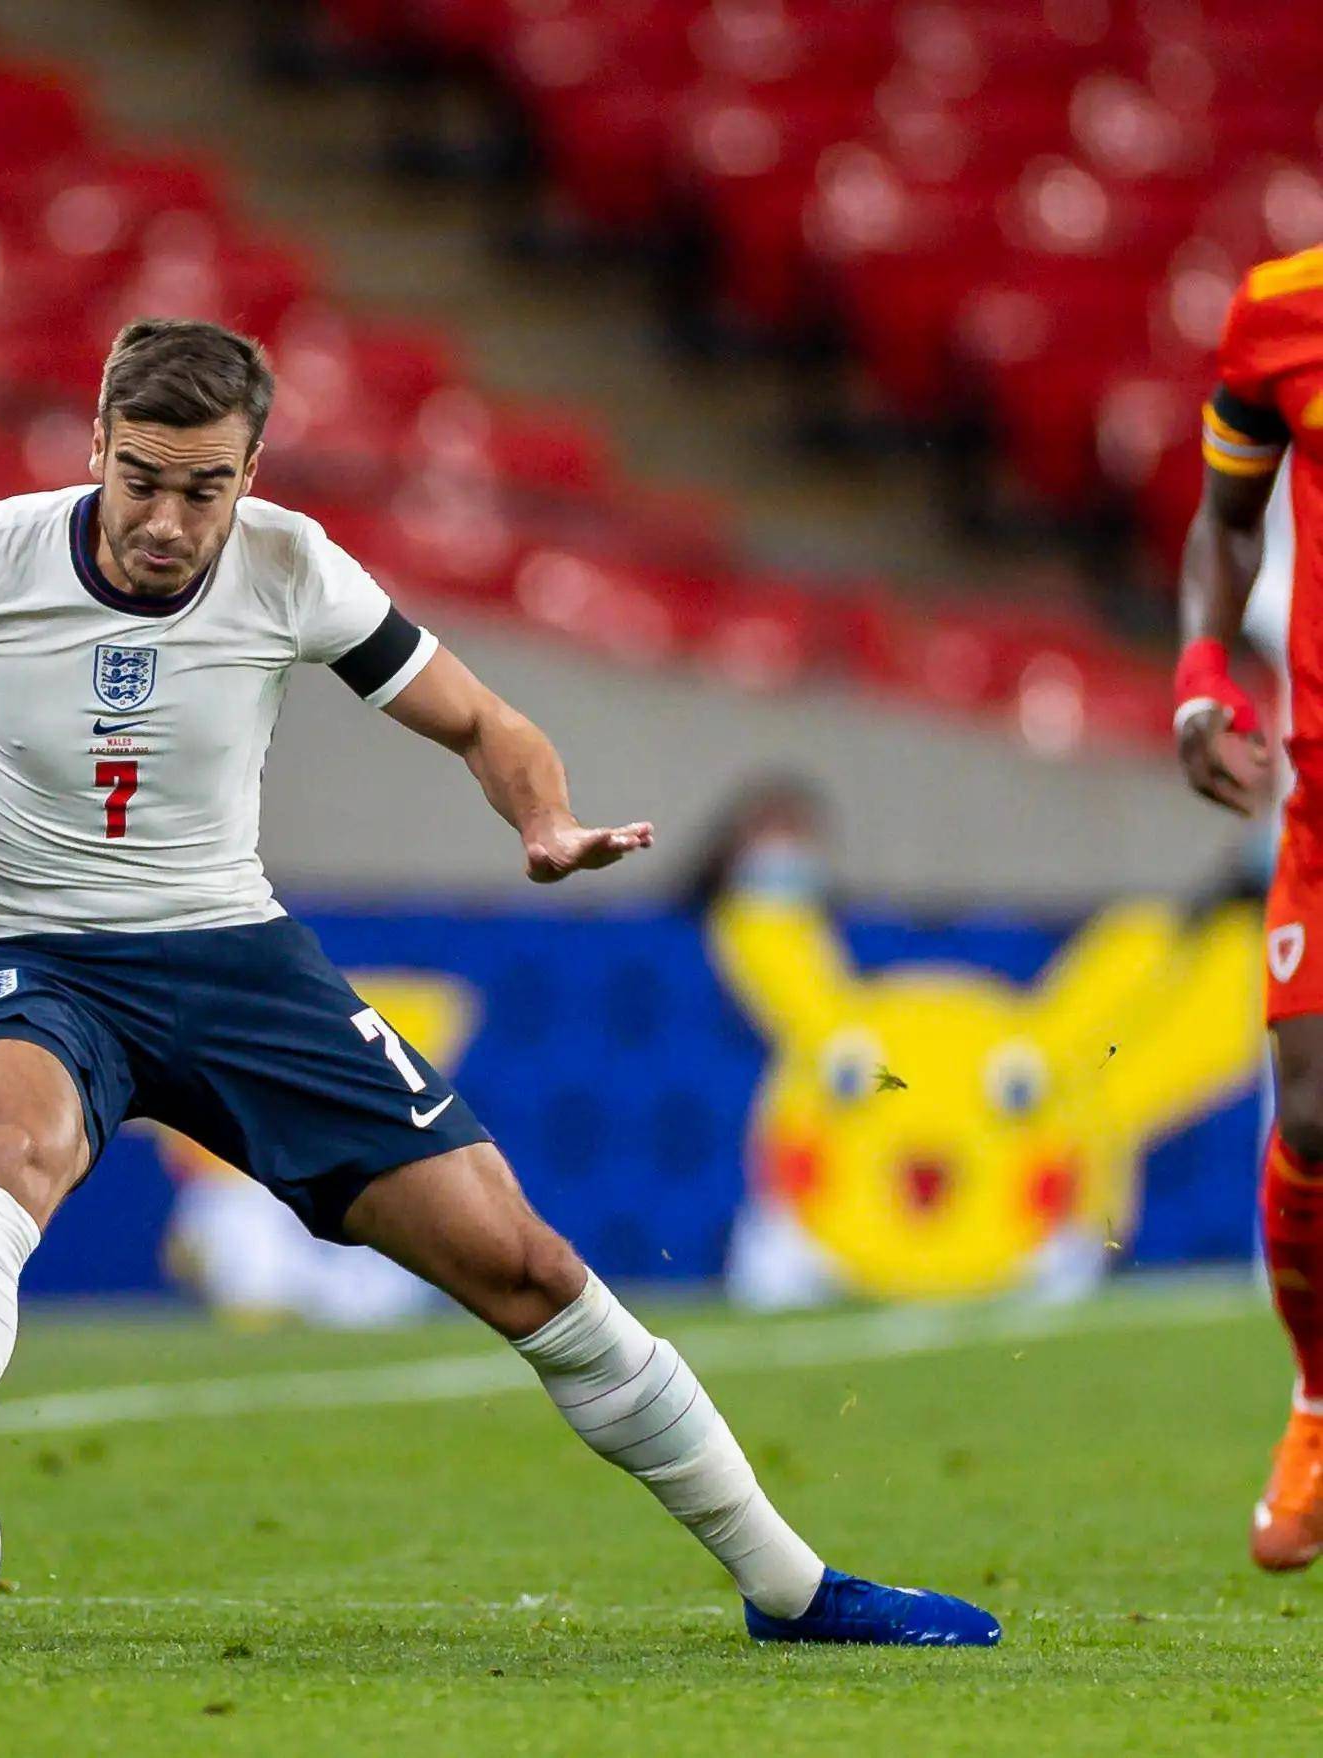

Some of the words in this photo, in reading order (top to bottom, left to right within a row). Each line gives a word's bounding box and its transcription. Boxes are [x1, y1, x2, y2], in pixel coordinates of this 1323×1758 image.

[106, 737, 132, 746] WALES
[95, 760, 138, 838] 7
[349, 1007, 426, 1093] 7
